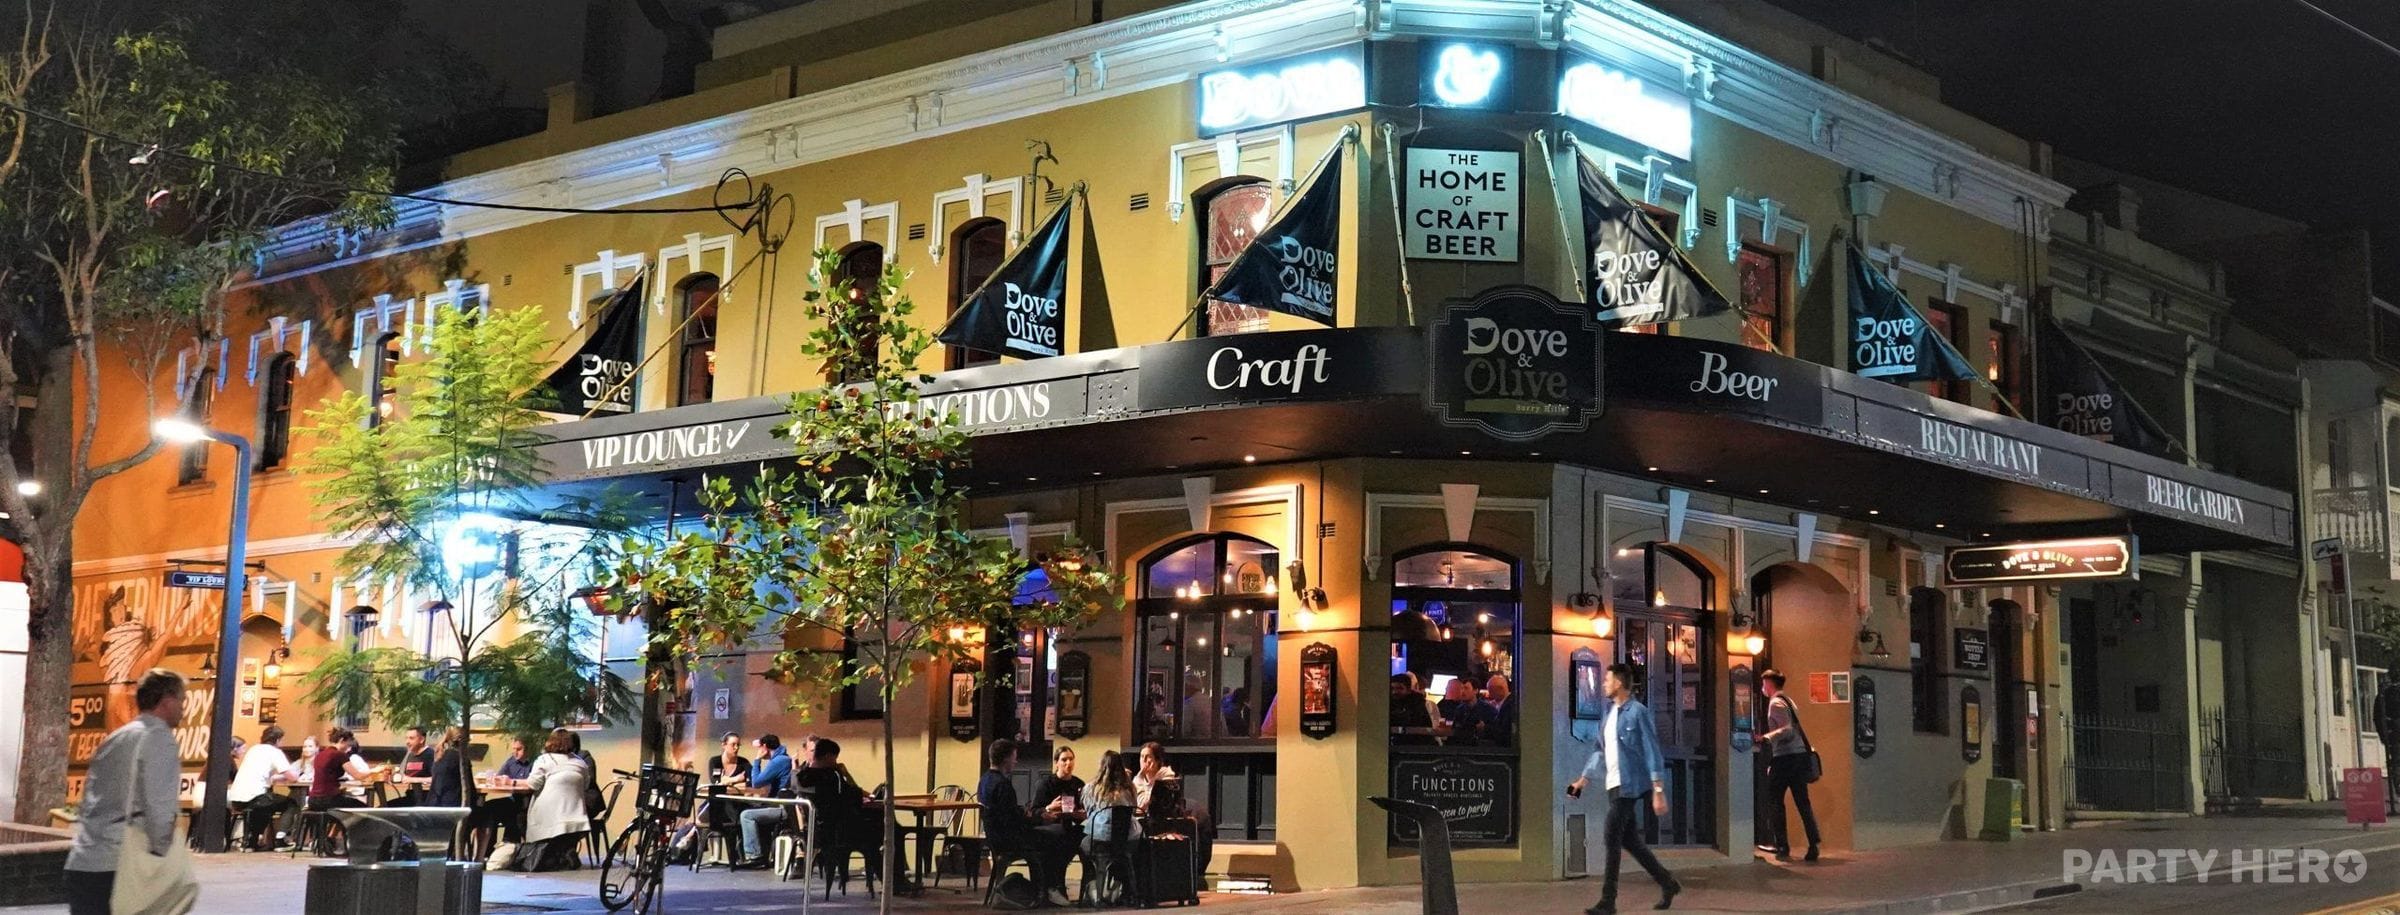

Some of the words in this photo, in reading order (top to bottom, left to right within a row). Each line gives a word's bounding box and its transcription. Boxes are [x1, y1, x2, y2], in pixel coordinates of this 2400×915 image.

[1448, 153, 1479, 166] THE
[1419, 169, 1506, 191] HOME
[1452, 195, 1473, 206] OF
[1416, 208, 1509, 231] CRAFT
[1280, 235, 1335, 273] Dove
[1426, 234, 1497, 256] BEER
[1310, 266, 1319, 278] &
[1595, 249, 1660, 280] Dove
[1627, 271, 1638, 282] &
[1279, 265, 1333, 303] Olive
[1596, 277, 1661, 307] Olive
[1004, 282, 1058, 317] Dove
[1007, 310, 1057, 345] Olive
[1029, 312, 1038, 323] &
[1855, 317, 1915, 341] Dove
[1463, 317, 1568, 357] Dove
[1887, 336, 1896, 346] &
[580, 353, 632, 379] Dove
[1517, 353, 1534, 368] &
[1857, 341, 1915, 366] Olive
[1207, 344, 1332, 394] Craft
[1464, 357, 1568, 399] Olive
[1690, 351, 1778, 401] Beer
[2056, 393, 2113, 416] Dove
[2058, 414, 2113, 435] Olive
[582, 436, 622, 469] VIP
[623, 423, 723, 465] LOUNGE
[1920, 417, 2042, 475] RESTAURANT
[2147, 474, 2186, 511] BEER
[2186, 485, 2244, 525] GARDEN
[2043, 550, 2075, 567] OLIVE
[172, 725, 211, 760] OUR
[1412, 774, 1495, 792] FUNCTIONS
